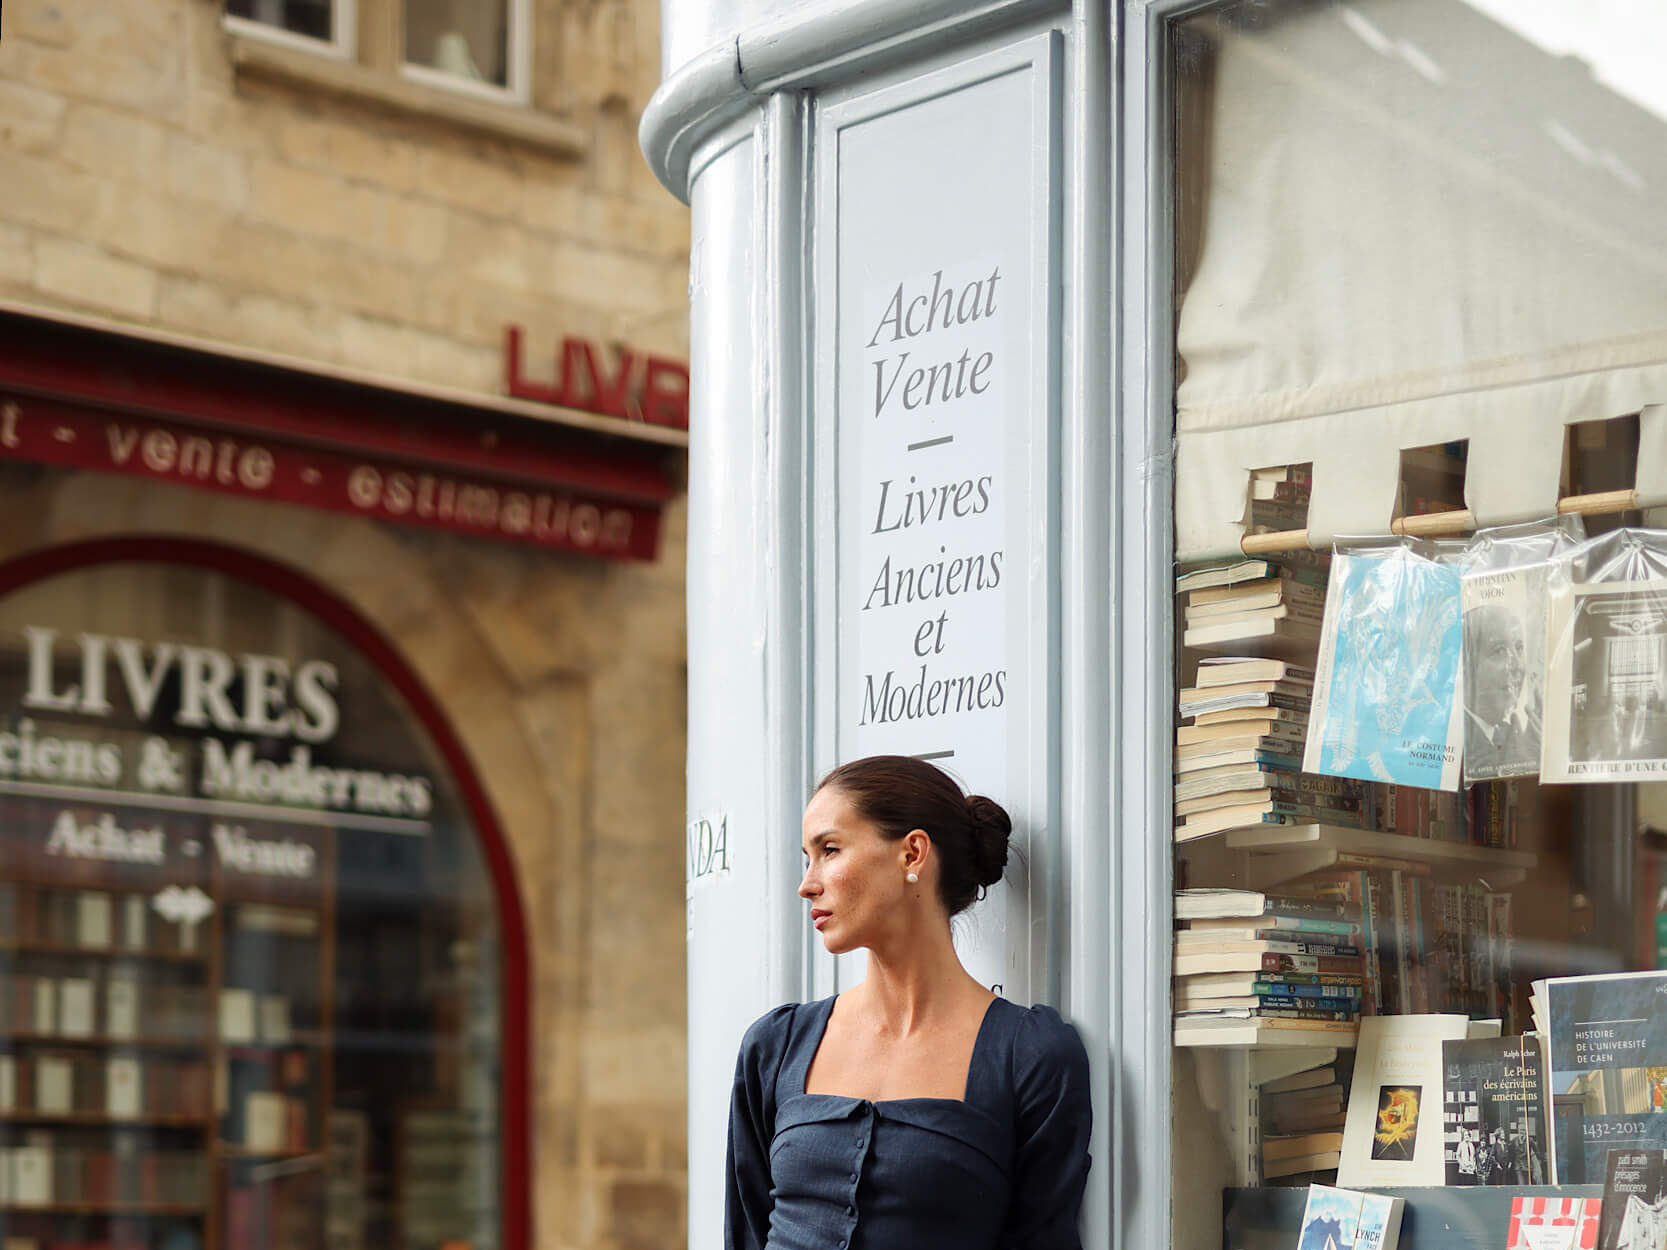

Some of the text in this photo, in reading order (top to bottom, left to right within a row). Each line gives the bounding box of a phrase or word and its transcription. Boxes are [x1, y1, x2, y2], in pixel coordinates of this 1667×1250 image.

[865, 265, 1001, 348] Achat
[872, 347, 993, 418] Vente
[106, 422, 275, 490] vente
[347, 464, 633, 548] estimation
[871, 476, 992, 534] Livres
[861, 545, 1002, 611] Anciens
[914, 609, 949, 657] et
[22, 626, 340, 743] LIVRES
[858, 664, 1006, 726] Modernes
[139, 736, 185, 791] &
[202, 737, 432, 816] Modernes
[1410, 750, 1455, 763] NORMAND
[47, 810, 165, 864] Achat
[211, 823, 315, 877] Vente
[1575, 1030, 1614, 1040] HISTOIRE
[1576, 1038, 1647, 1052] DE L'UNIVERSITÉ
[1577, 1053, 1613, 1064] DE CAEN
[1483, 1079, 1498, 1089] des
[1491, 1091, 1538, 1102] américans
[1503, 1066, 1515, 1077] Le
[1583, 1121, 1648, 1138] 1432-2012
